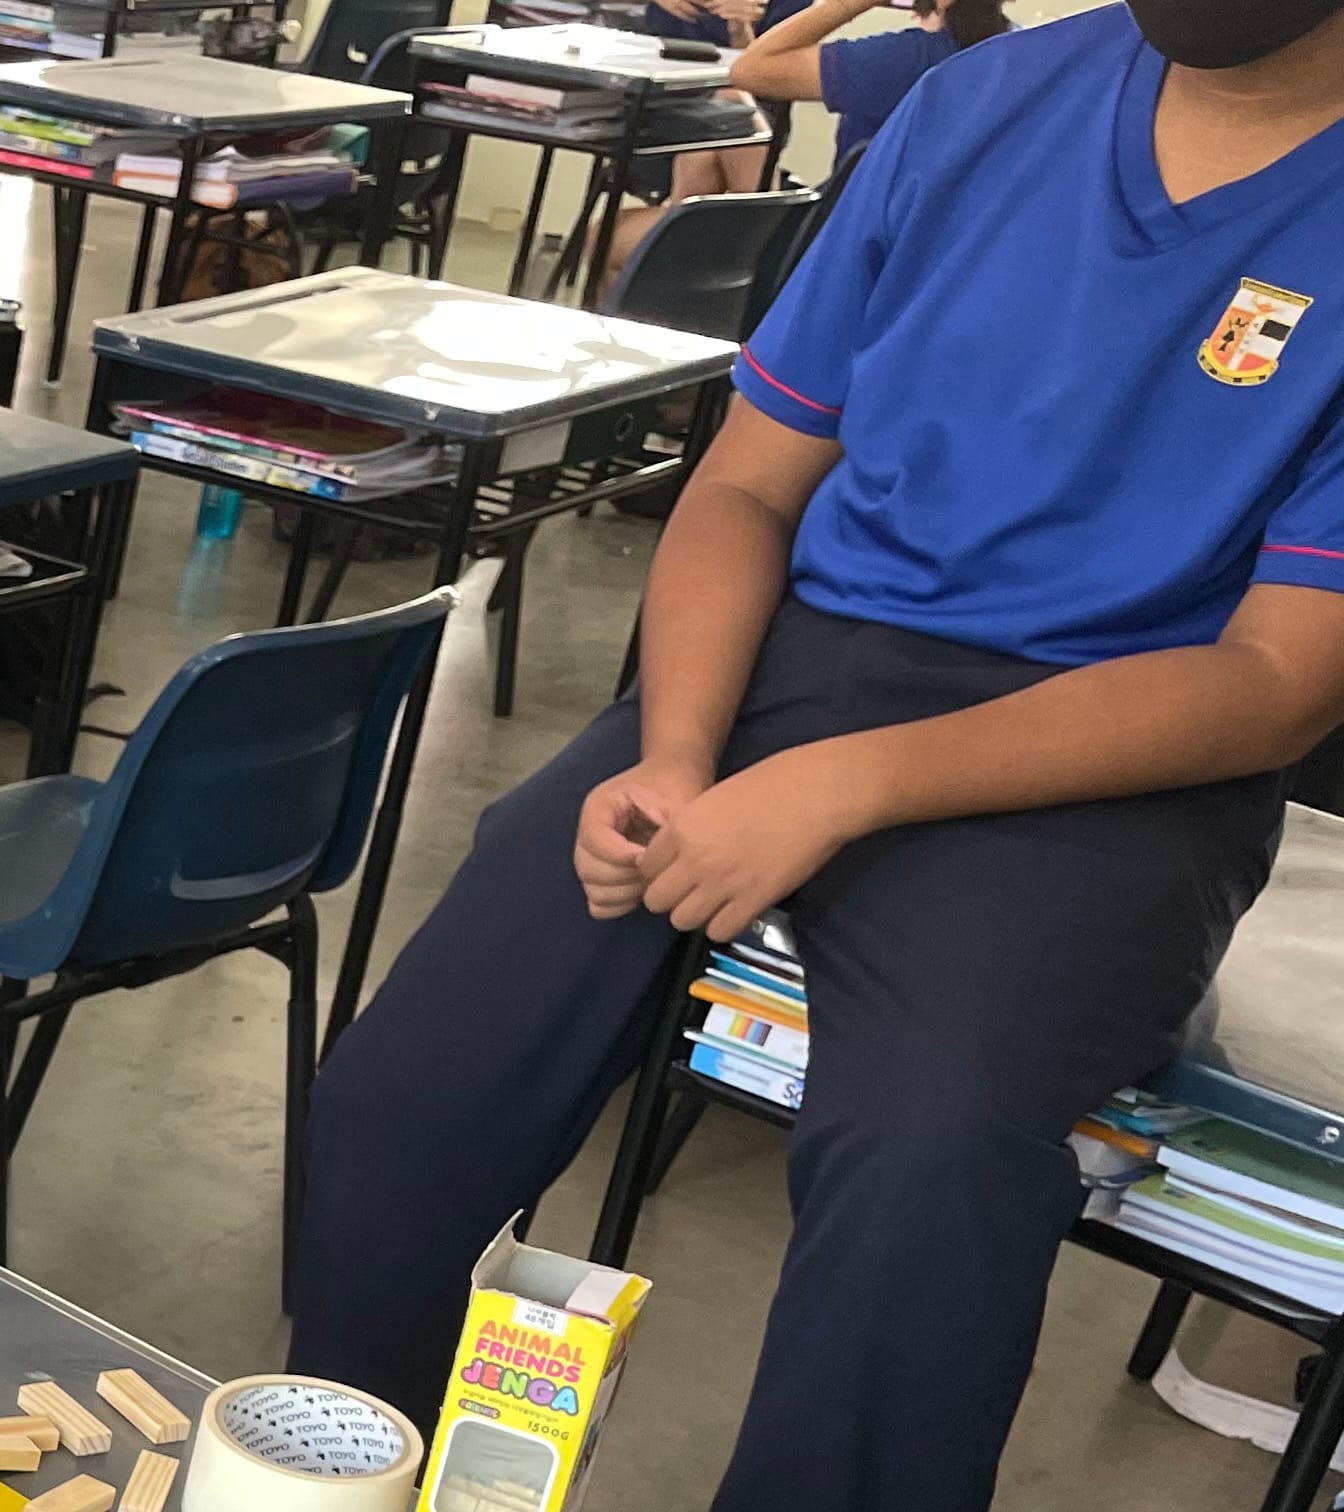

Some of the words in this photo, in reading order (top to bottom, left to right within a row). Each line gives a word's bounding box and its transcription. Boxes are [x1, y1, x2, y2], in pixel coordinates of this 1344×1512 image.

[479, 1319, 585, 1366] ANIMAL
[475, 1336, 581, 1383] FRIENDS
[461, 1357, 579, 1416] JENGA
[251, 1392, 279, 1409] TOYO
[265, 1400, 294, 1416] TOYO
[280, 1411, 311, 1423] TOYO
[333, 1407, 363, 1416] TOYO
[246, 1434, 274, 1449] TOYO
[296, 1423, 327, 1433] TOYO
[349, 1422, 375, 1432] TOYO
[527, 1420, 570, 1441] 1500G
[260, 1443, 290, 1456] TOYO
[312, 1437, 343, 1446] TOYO
[362, 1437, 384, 1449] TOYO
[275, 1454, 306, 1464] TOYO
[328, 1451, 357, 1461] TOYO
